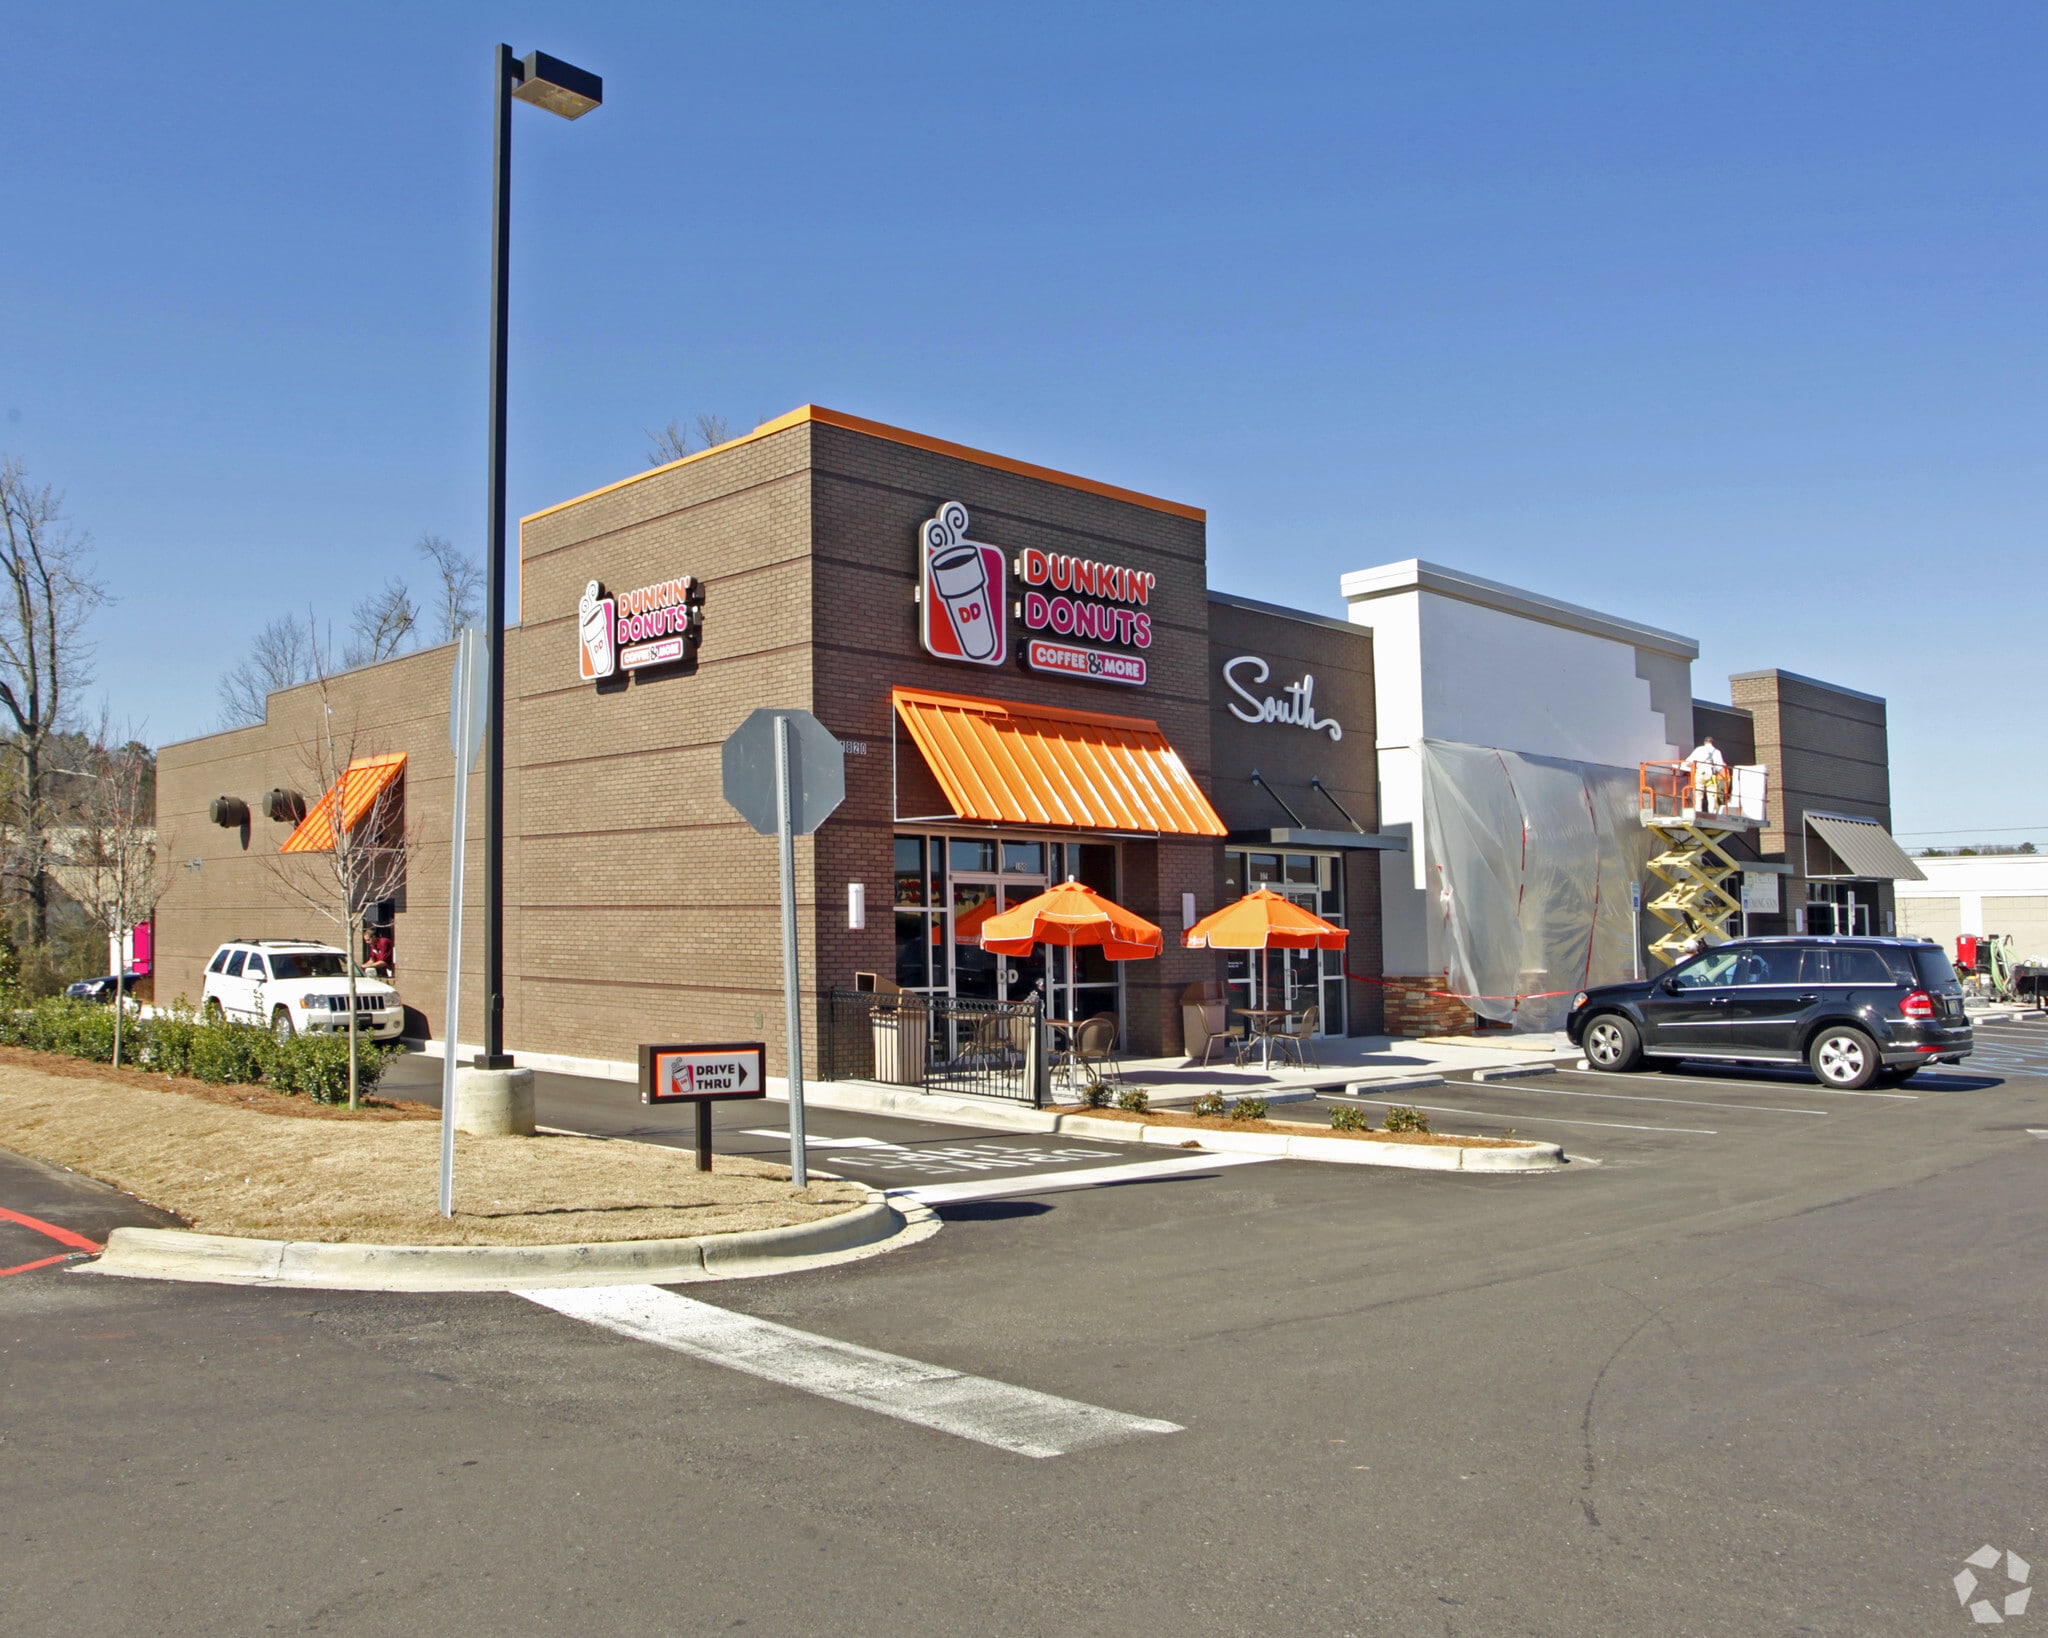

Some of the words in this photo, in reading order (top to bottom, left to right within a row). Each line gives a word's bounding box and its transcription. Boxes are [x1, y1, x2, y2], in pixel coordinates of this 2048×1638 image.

[1022, 547, 1155, 606] DUNKIN'
[618, 575, 691, 618] DUNKIN'
[618, 604, 687, 644] DONUTS
[958, 603, 981, 624] DD
[1024, 591, 1151, 648] DONUTS
[1036, 647, 1086, 669] COFFEE
[1087, 652, 1102, 674] &
[1104, 661, 1140, 678] MORE
[1223, 656, 1342, 741] South
[841, 741, 867, 755] 820
[996, 969, 1019, 984] DD
[696, 1064, 735, 1076] DRIVE
[696, 1078, 731, 1090] THRU
